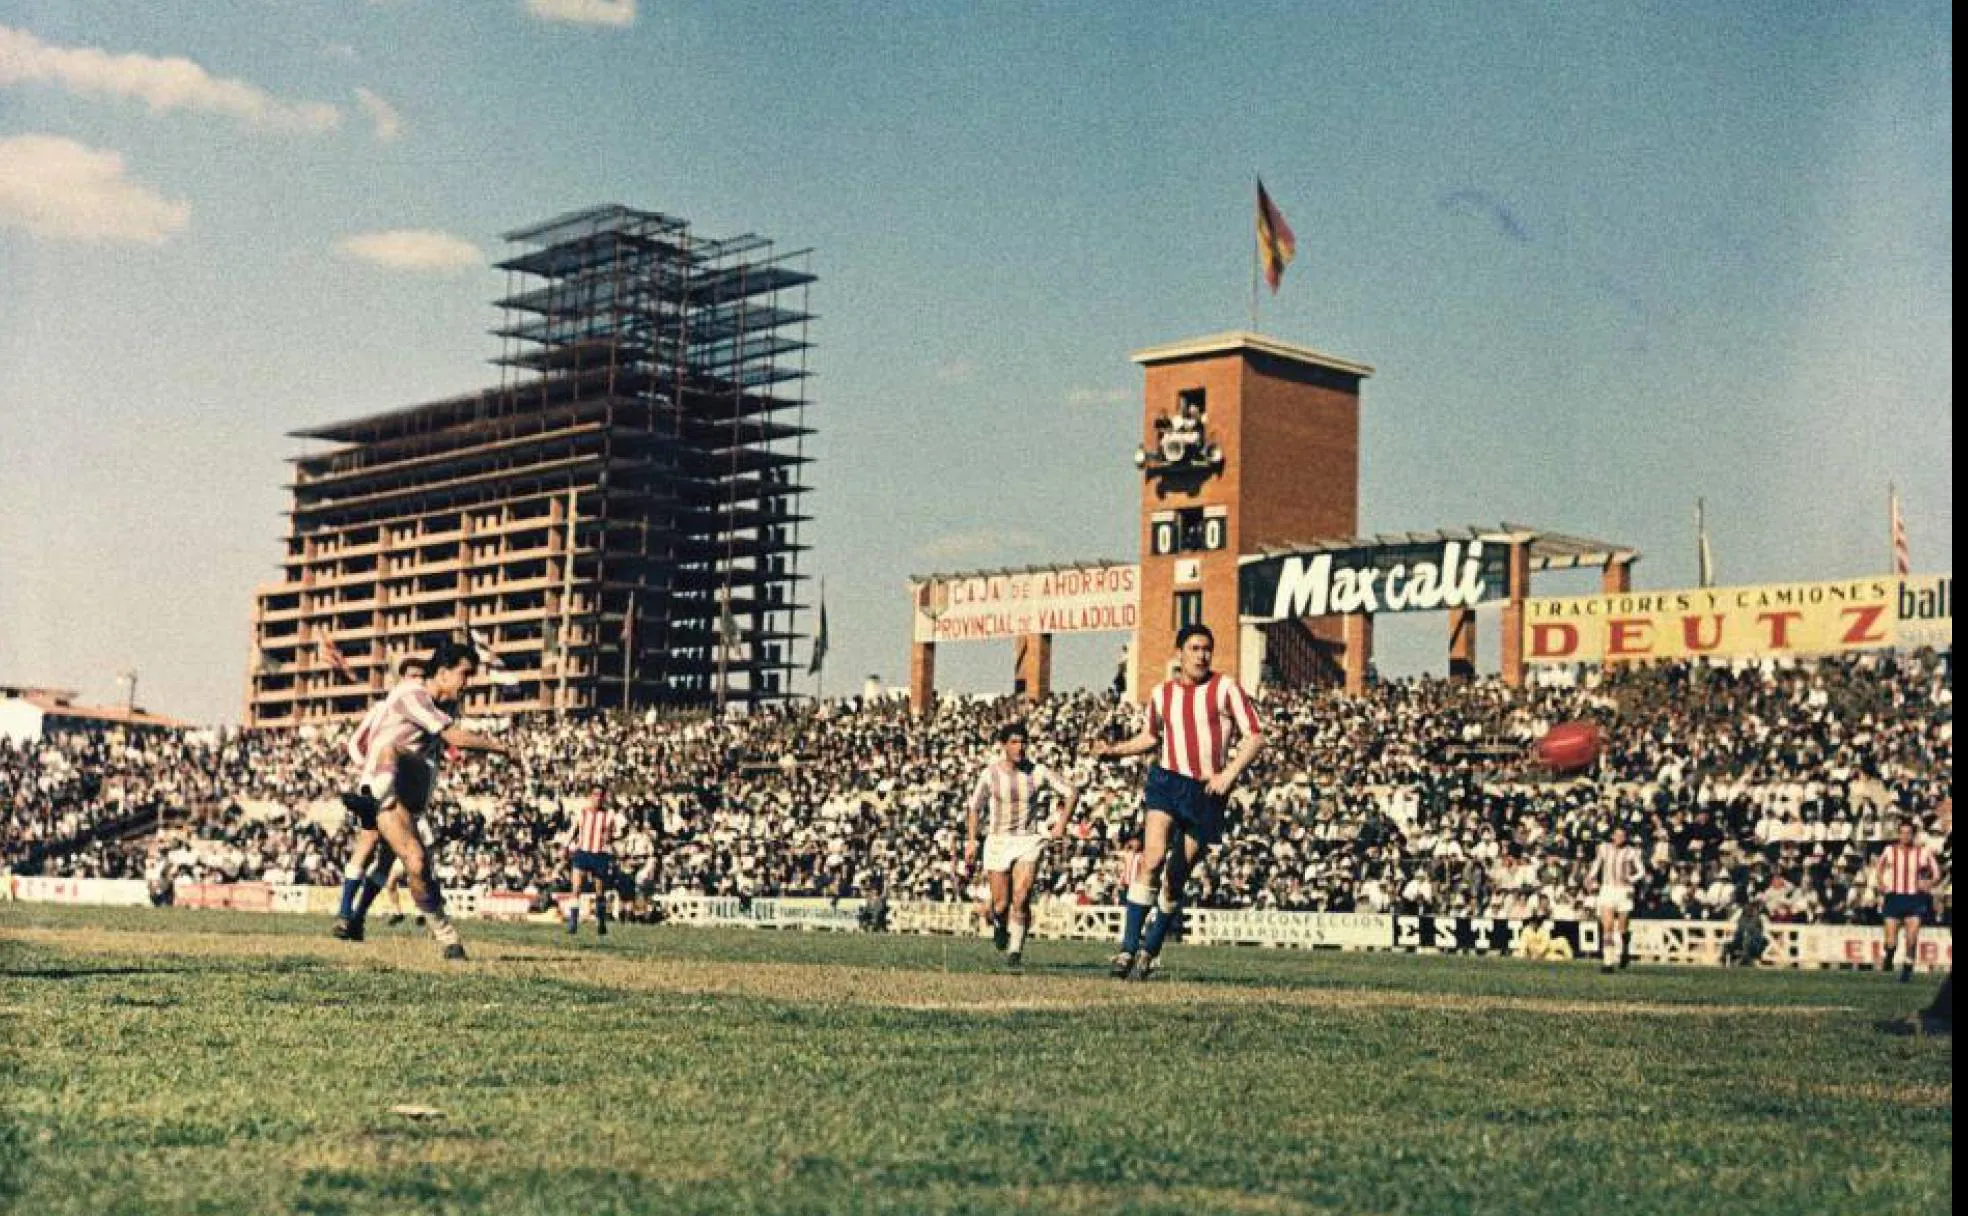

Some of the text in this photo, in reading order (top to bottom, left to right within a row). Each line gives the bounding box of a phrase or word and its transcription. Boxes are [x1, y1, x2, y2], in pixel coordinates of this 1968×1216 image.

[953, 568, 1134, 605] CAJA DE AHORROS
[1274, 541, 1485, 619] Maxcali
[1532, 582, 1885, 616] TRACTORES Y CAMIONES
[933, 612, 1014, 640] PROVINCIAL
[1038, 603, 1136, 630] VALLADOLID
[1530, 603, 1888, 657] DEUTZ
